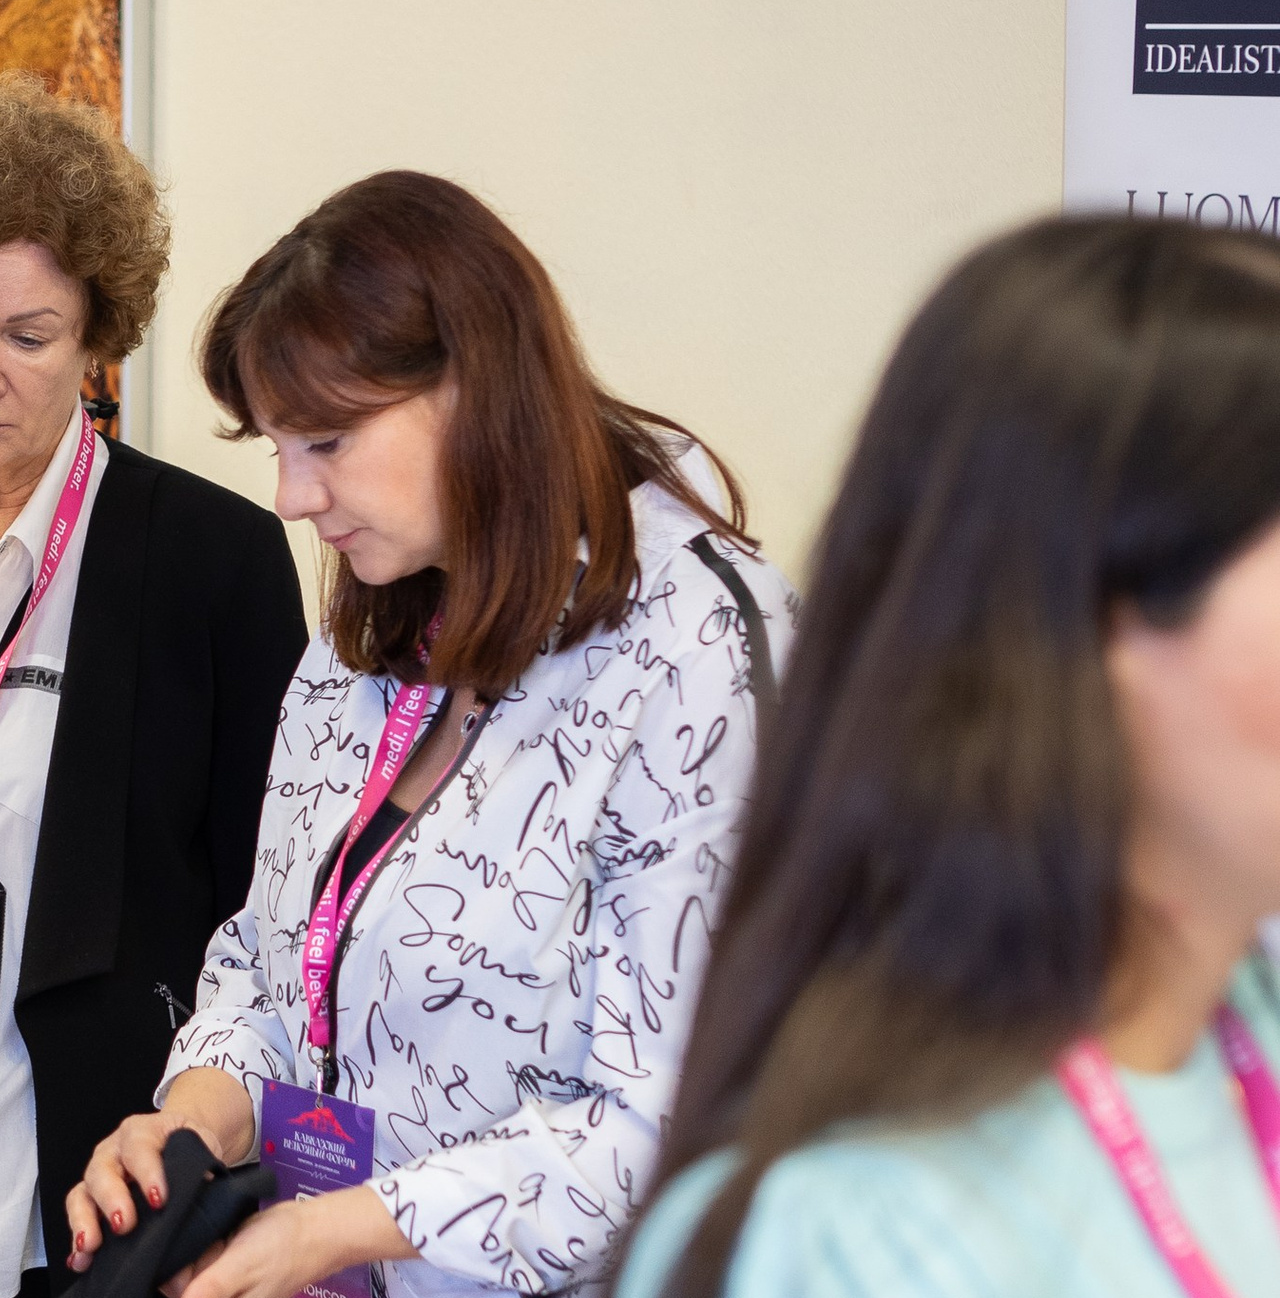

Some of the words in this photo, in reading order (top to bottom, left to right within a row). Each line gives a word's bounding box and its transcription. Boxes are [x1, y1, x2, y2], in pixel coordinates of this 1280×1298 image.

[1145, 44, 1280, 74] IDEALIST
[70, 443, 93, 492] better.
[47, 517, 67, 562] medi.
[21, 669, 61, 691] EM
[381, 732, 409, 780] medi.
[308, 926, 330, 964] feel
